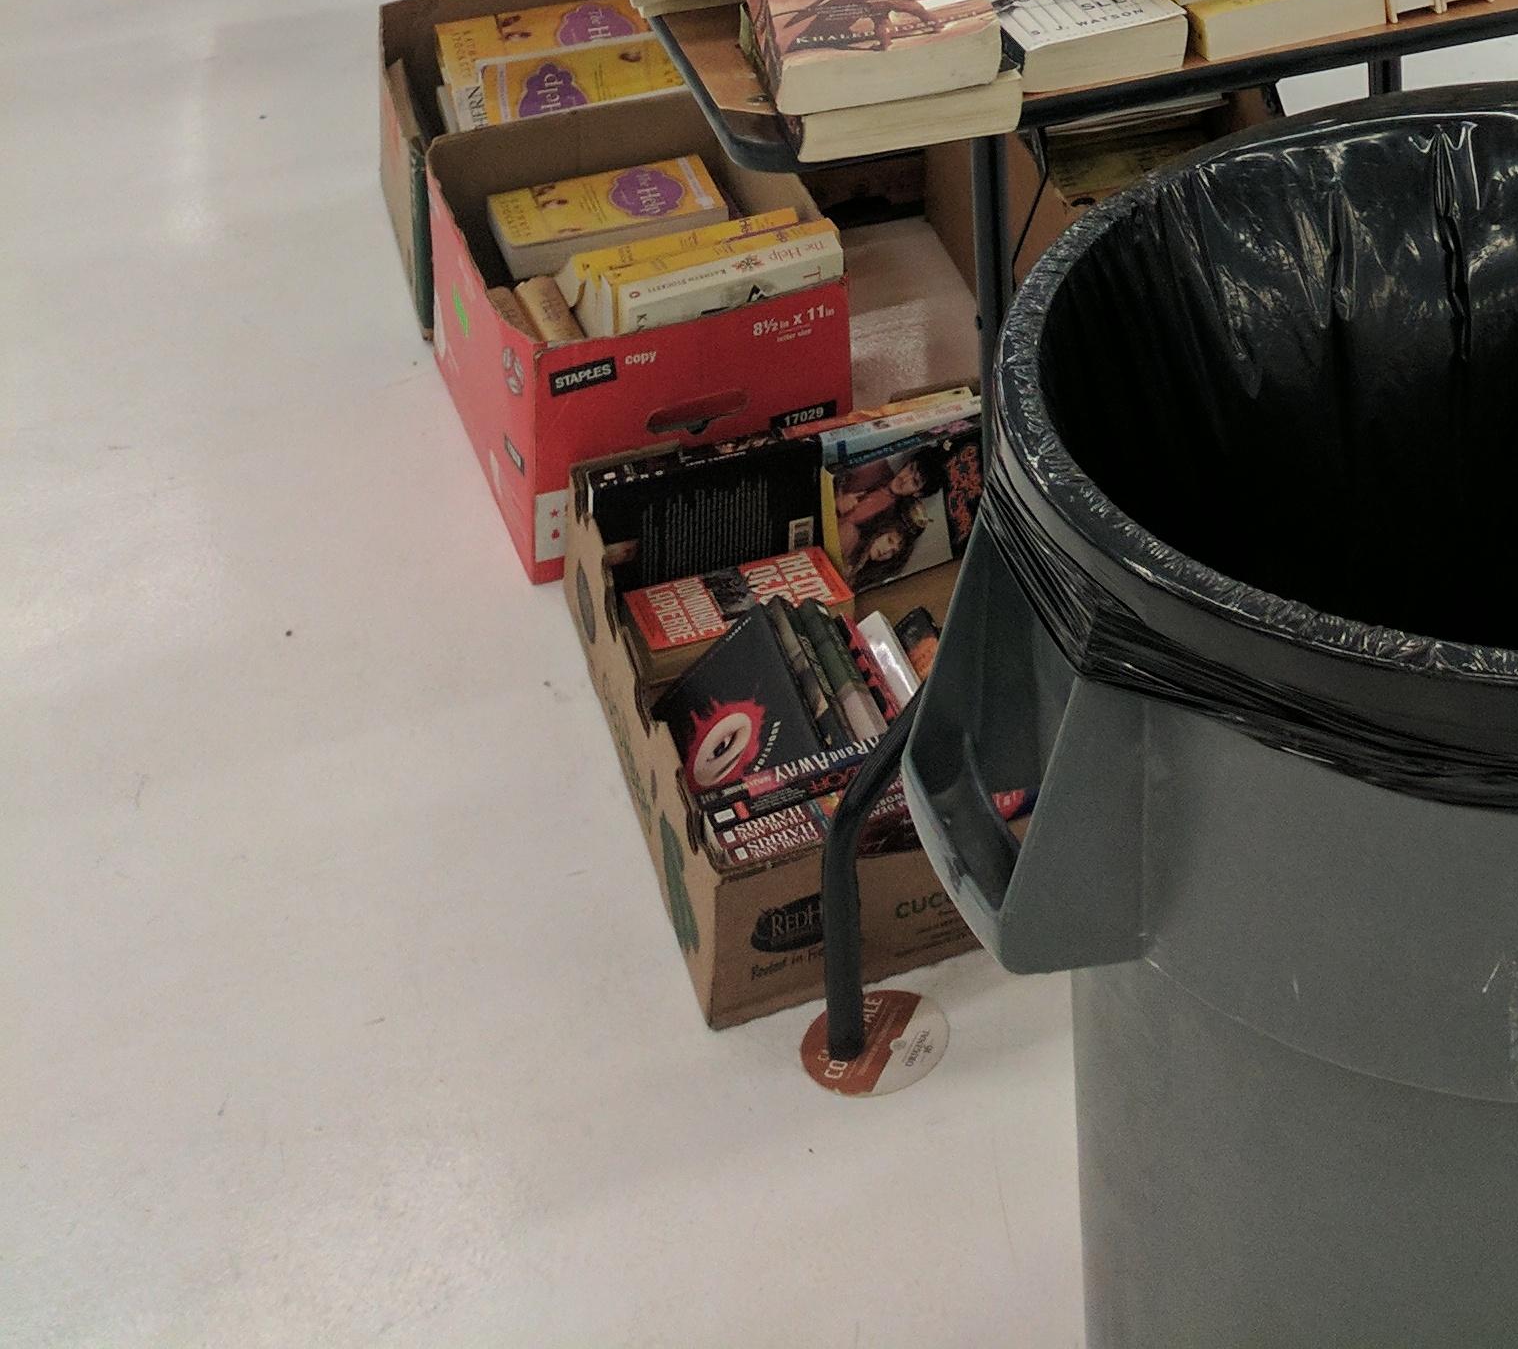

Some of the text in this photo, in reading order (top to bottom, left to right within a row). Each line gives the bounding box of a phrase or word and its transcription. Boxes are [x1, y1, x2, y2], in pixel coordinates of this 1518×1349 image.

[1075, 7, 1144, 27] WATSON
[796, 29, 876, 44] KHALED
[638, 186, 663, 217] Help
[768, 245, 803, 264] Help
[802, 239, 828, 254] The
[793, 313, 803, 326] x
[624, 349, 658, 366] copy
[554, 363, 612, 390] STAPLES
[783, 405, 825, 427] 17029
[645, 588, 697, 645] LAPIERRE
[774, 751, 830, 783] AWAY
[734, 804, 806, 835] HARRIS
[746, 821, 817, 853] HARRIS
